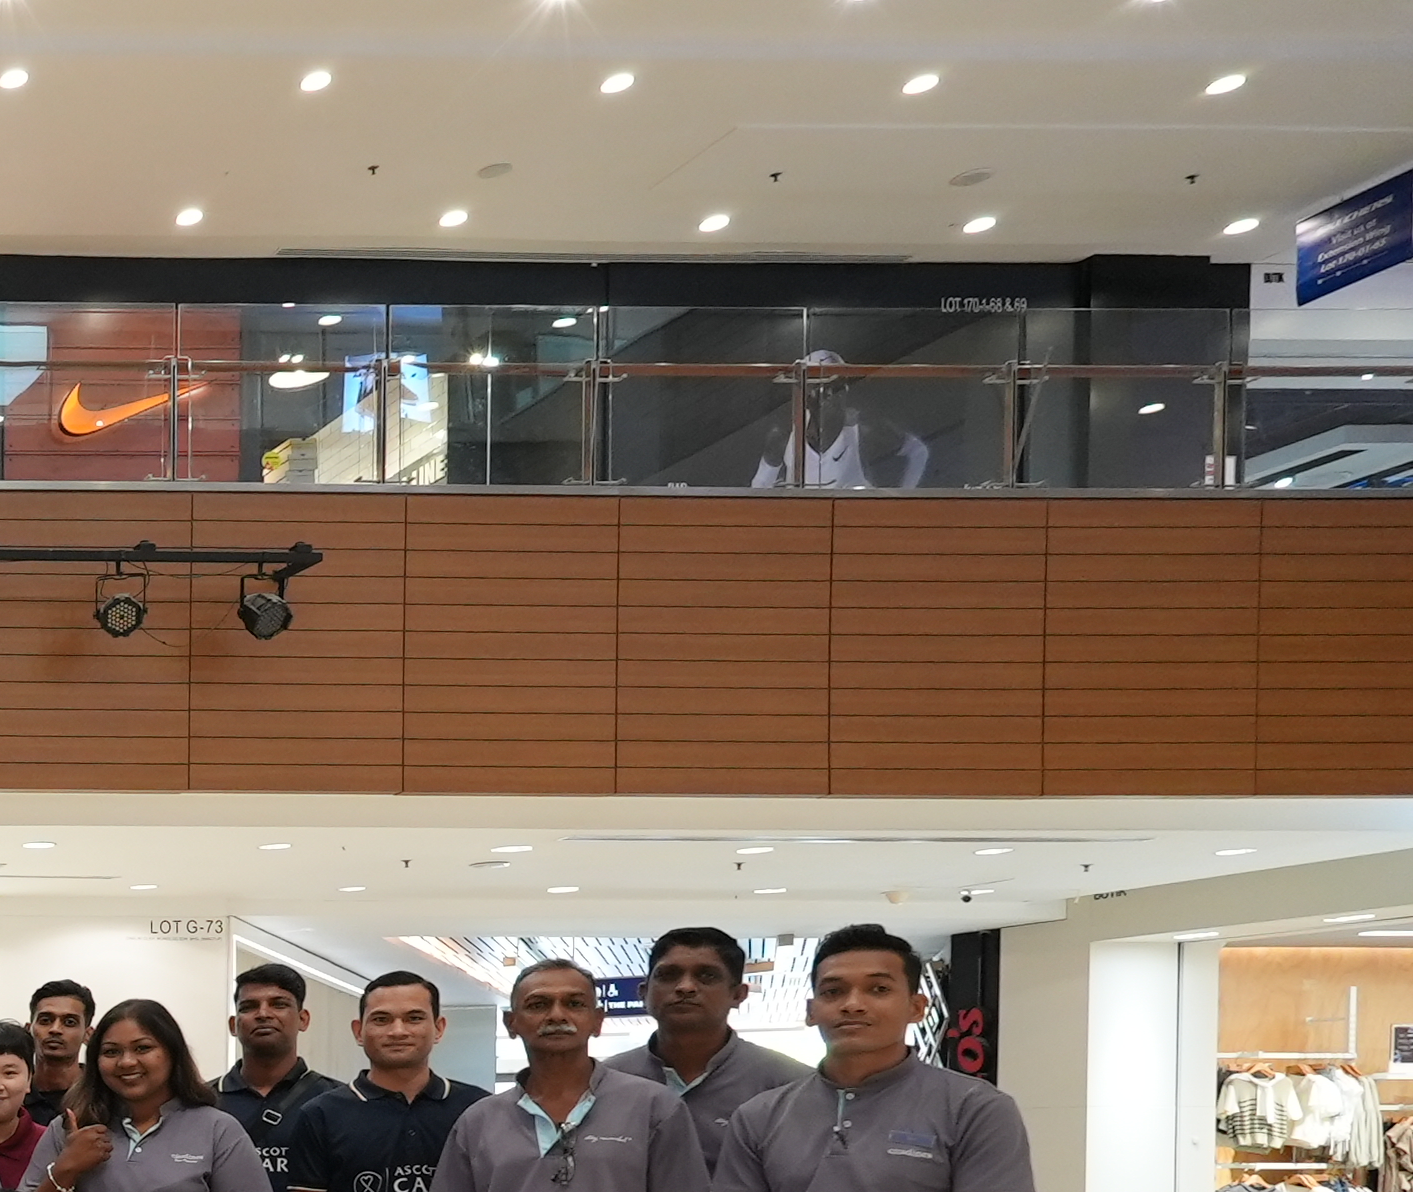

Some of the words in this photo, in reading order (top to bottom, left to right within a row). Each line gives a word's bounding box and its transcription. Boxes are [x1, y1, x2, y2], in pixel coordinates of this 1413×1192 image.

[941, 297, 962, 312] LOT
[150, 919, 182, 934] LOT
[186, 919, 224, 934] G-73
[255, 1146, 290, 1158] SCOT
